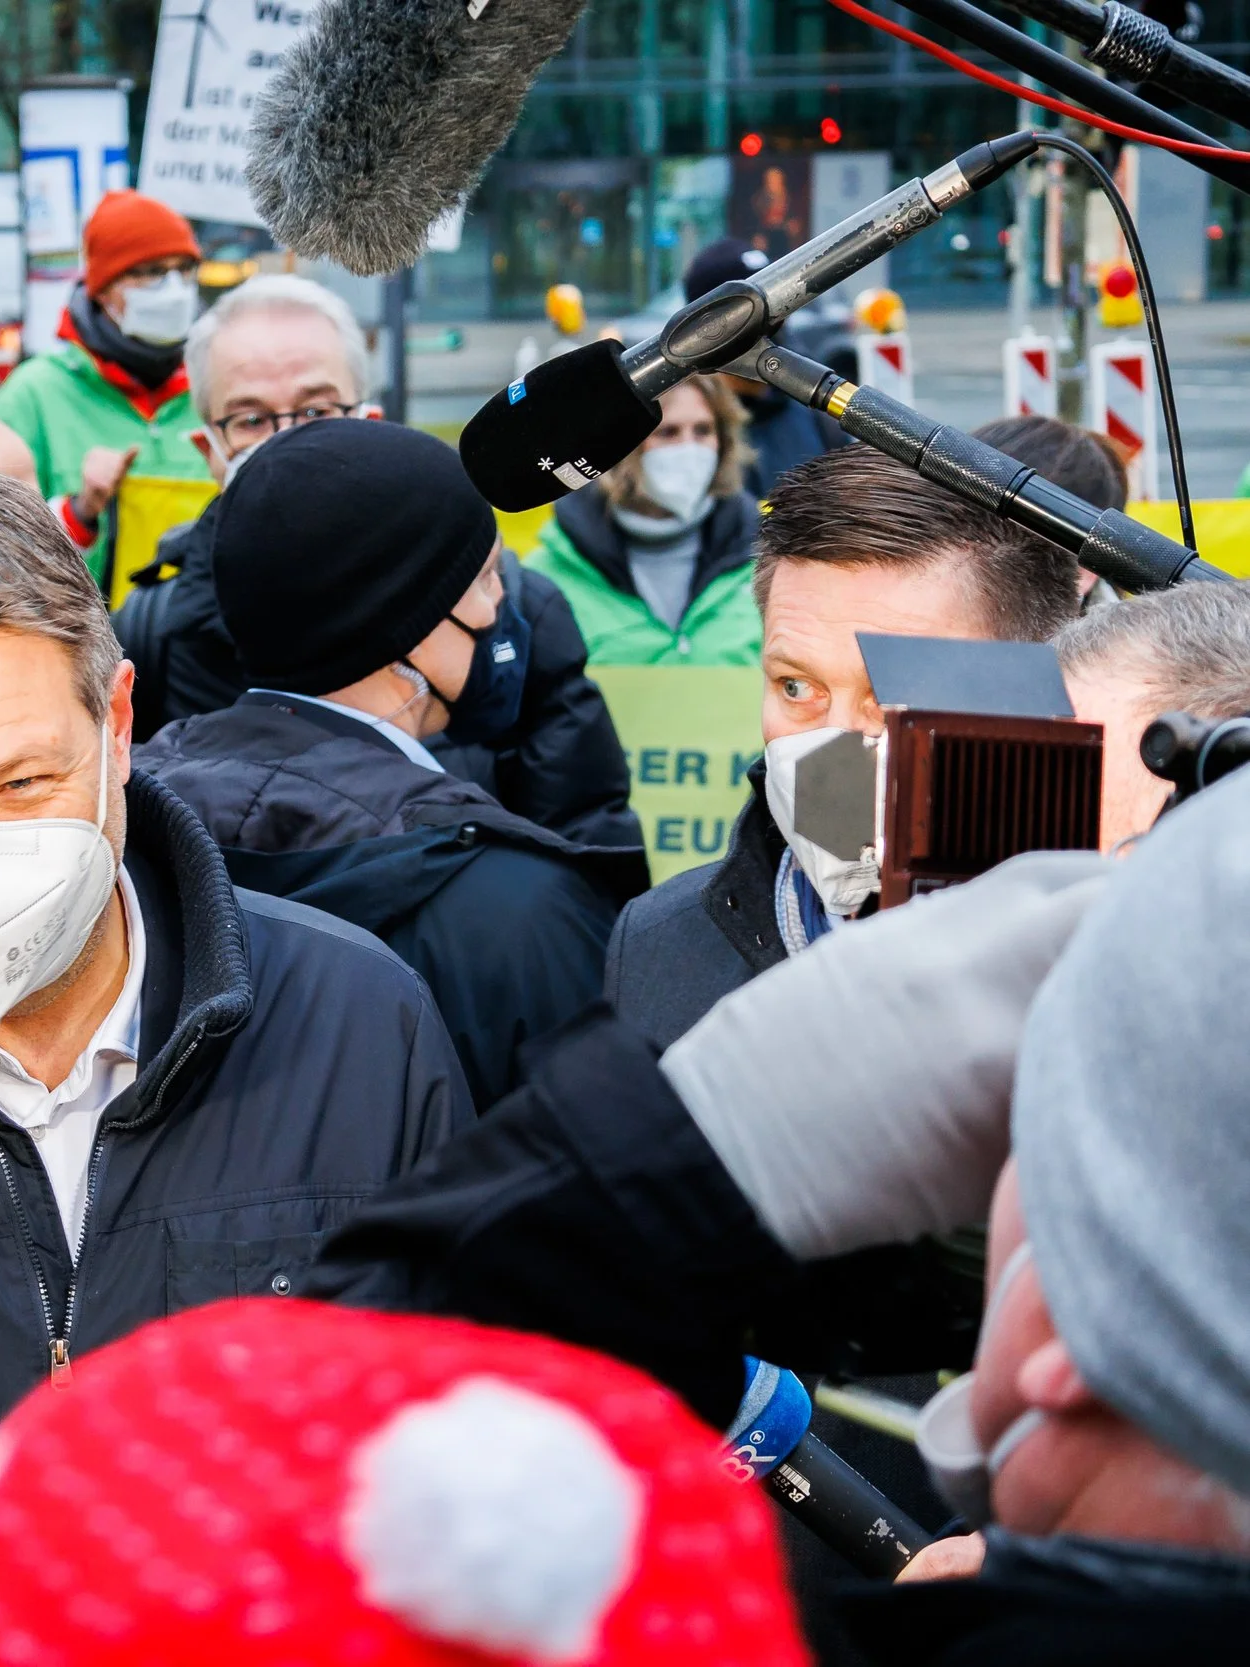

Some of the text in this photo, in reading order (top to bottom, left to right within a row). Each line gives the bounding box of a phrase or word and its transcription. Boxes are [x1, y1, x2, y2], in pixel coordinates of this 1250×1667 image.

[574, 457, 602, 479] LIVE
[624, 747, 708, 787] ER
[720, 1445, 777, 1484] BR
[788, 1487, 805, 1503] BR
